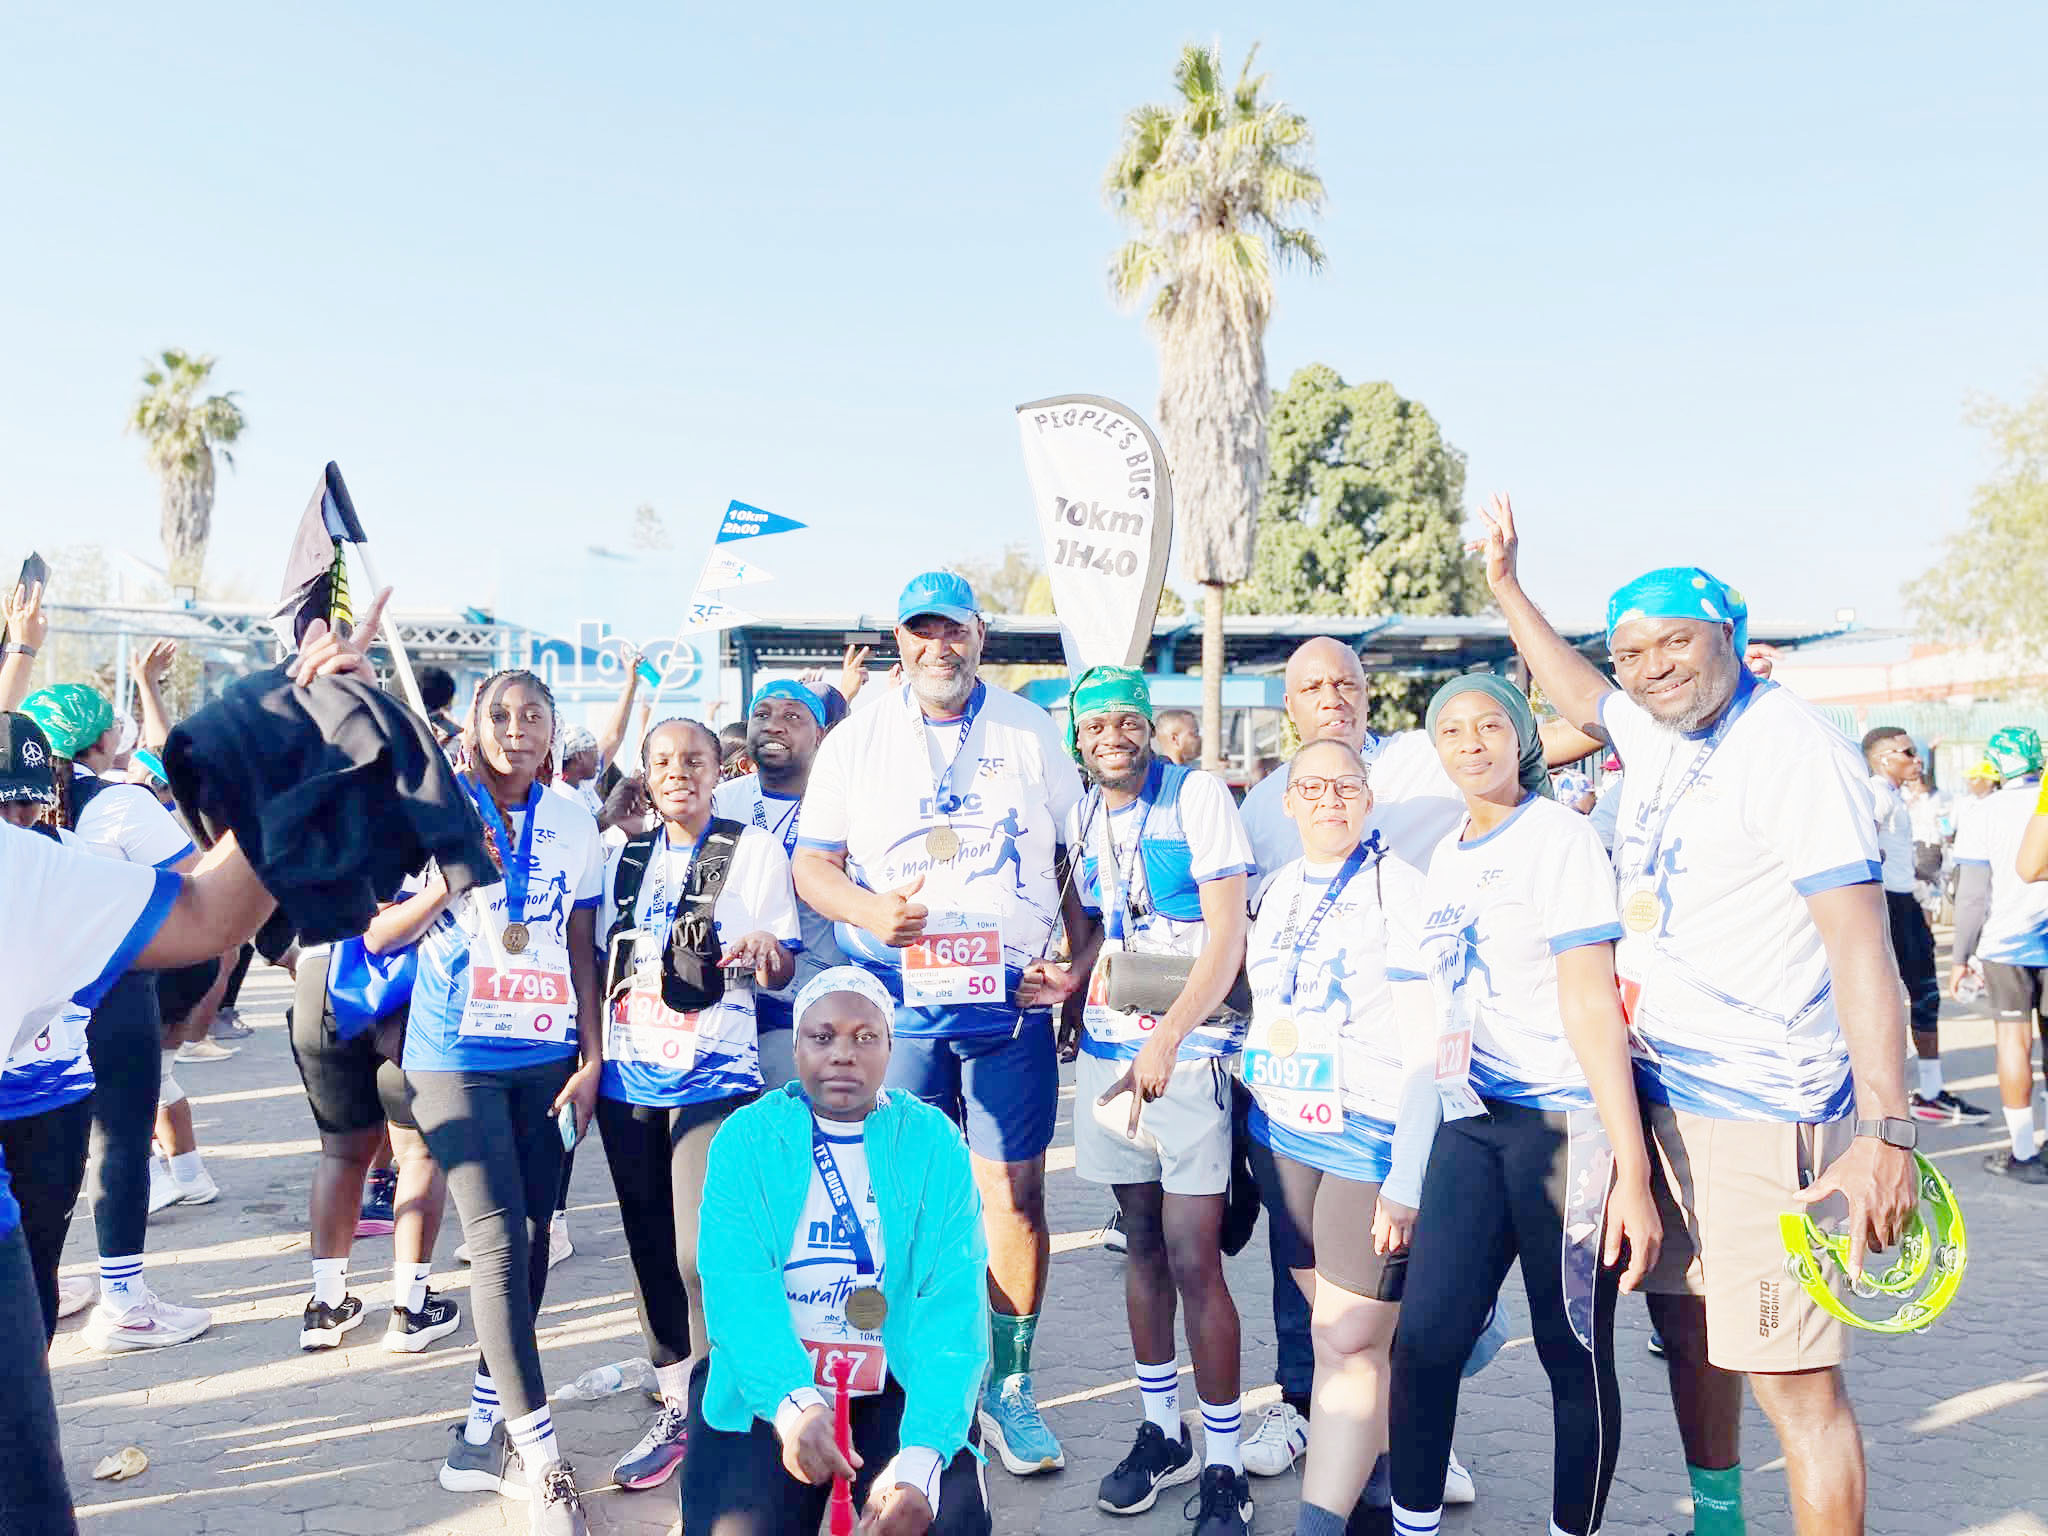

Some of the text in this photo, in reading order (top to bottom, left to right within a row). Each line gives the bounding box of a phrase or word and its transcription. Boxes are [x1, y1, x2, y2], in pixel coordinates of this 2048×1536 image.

[1034, 408, 1150, 500] PEOPLE'S BUS
[721, 522, 760, 535] 2h00
[729, 509, 769, 522] 10km
[1054, 496, 1144, 536] 10km
[1054, 539, 1138, 578] 1H40
[1426, 903, 1466, 925] nbc
[919, 936, 988, 966] 1662
[488, 973, 557, 1001] 1796
[968, 976, 996, 995] 50
[1253, 1053, 1319, 1087] 5097
[1299, 1103, 1332, 1125] 40
[814, 1143, 848, 1207] IT'S OURS
[1759, 1280, 1770, 1338] SPIRITO
[1770, 1281, 1780, 1329] ORIGINAL
